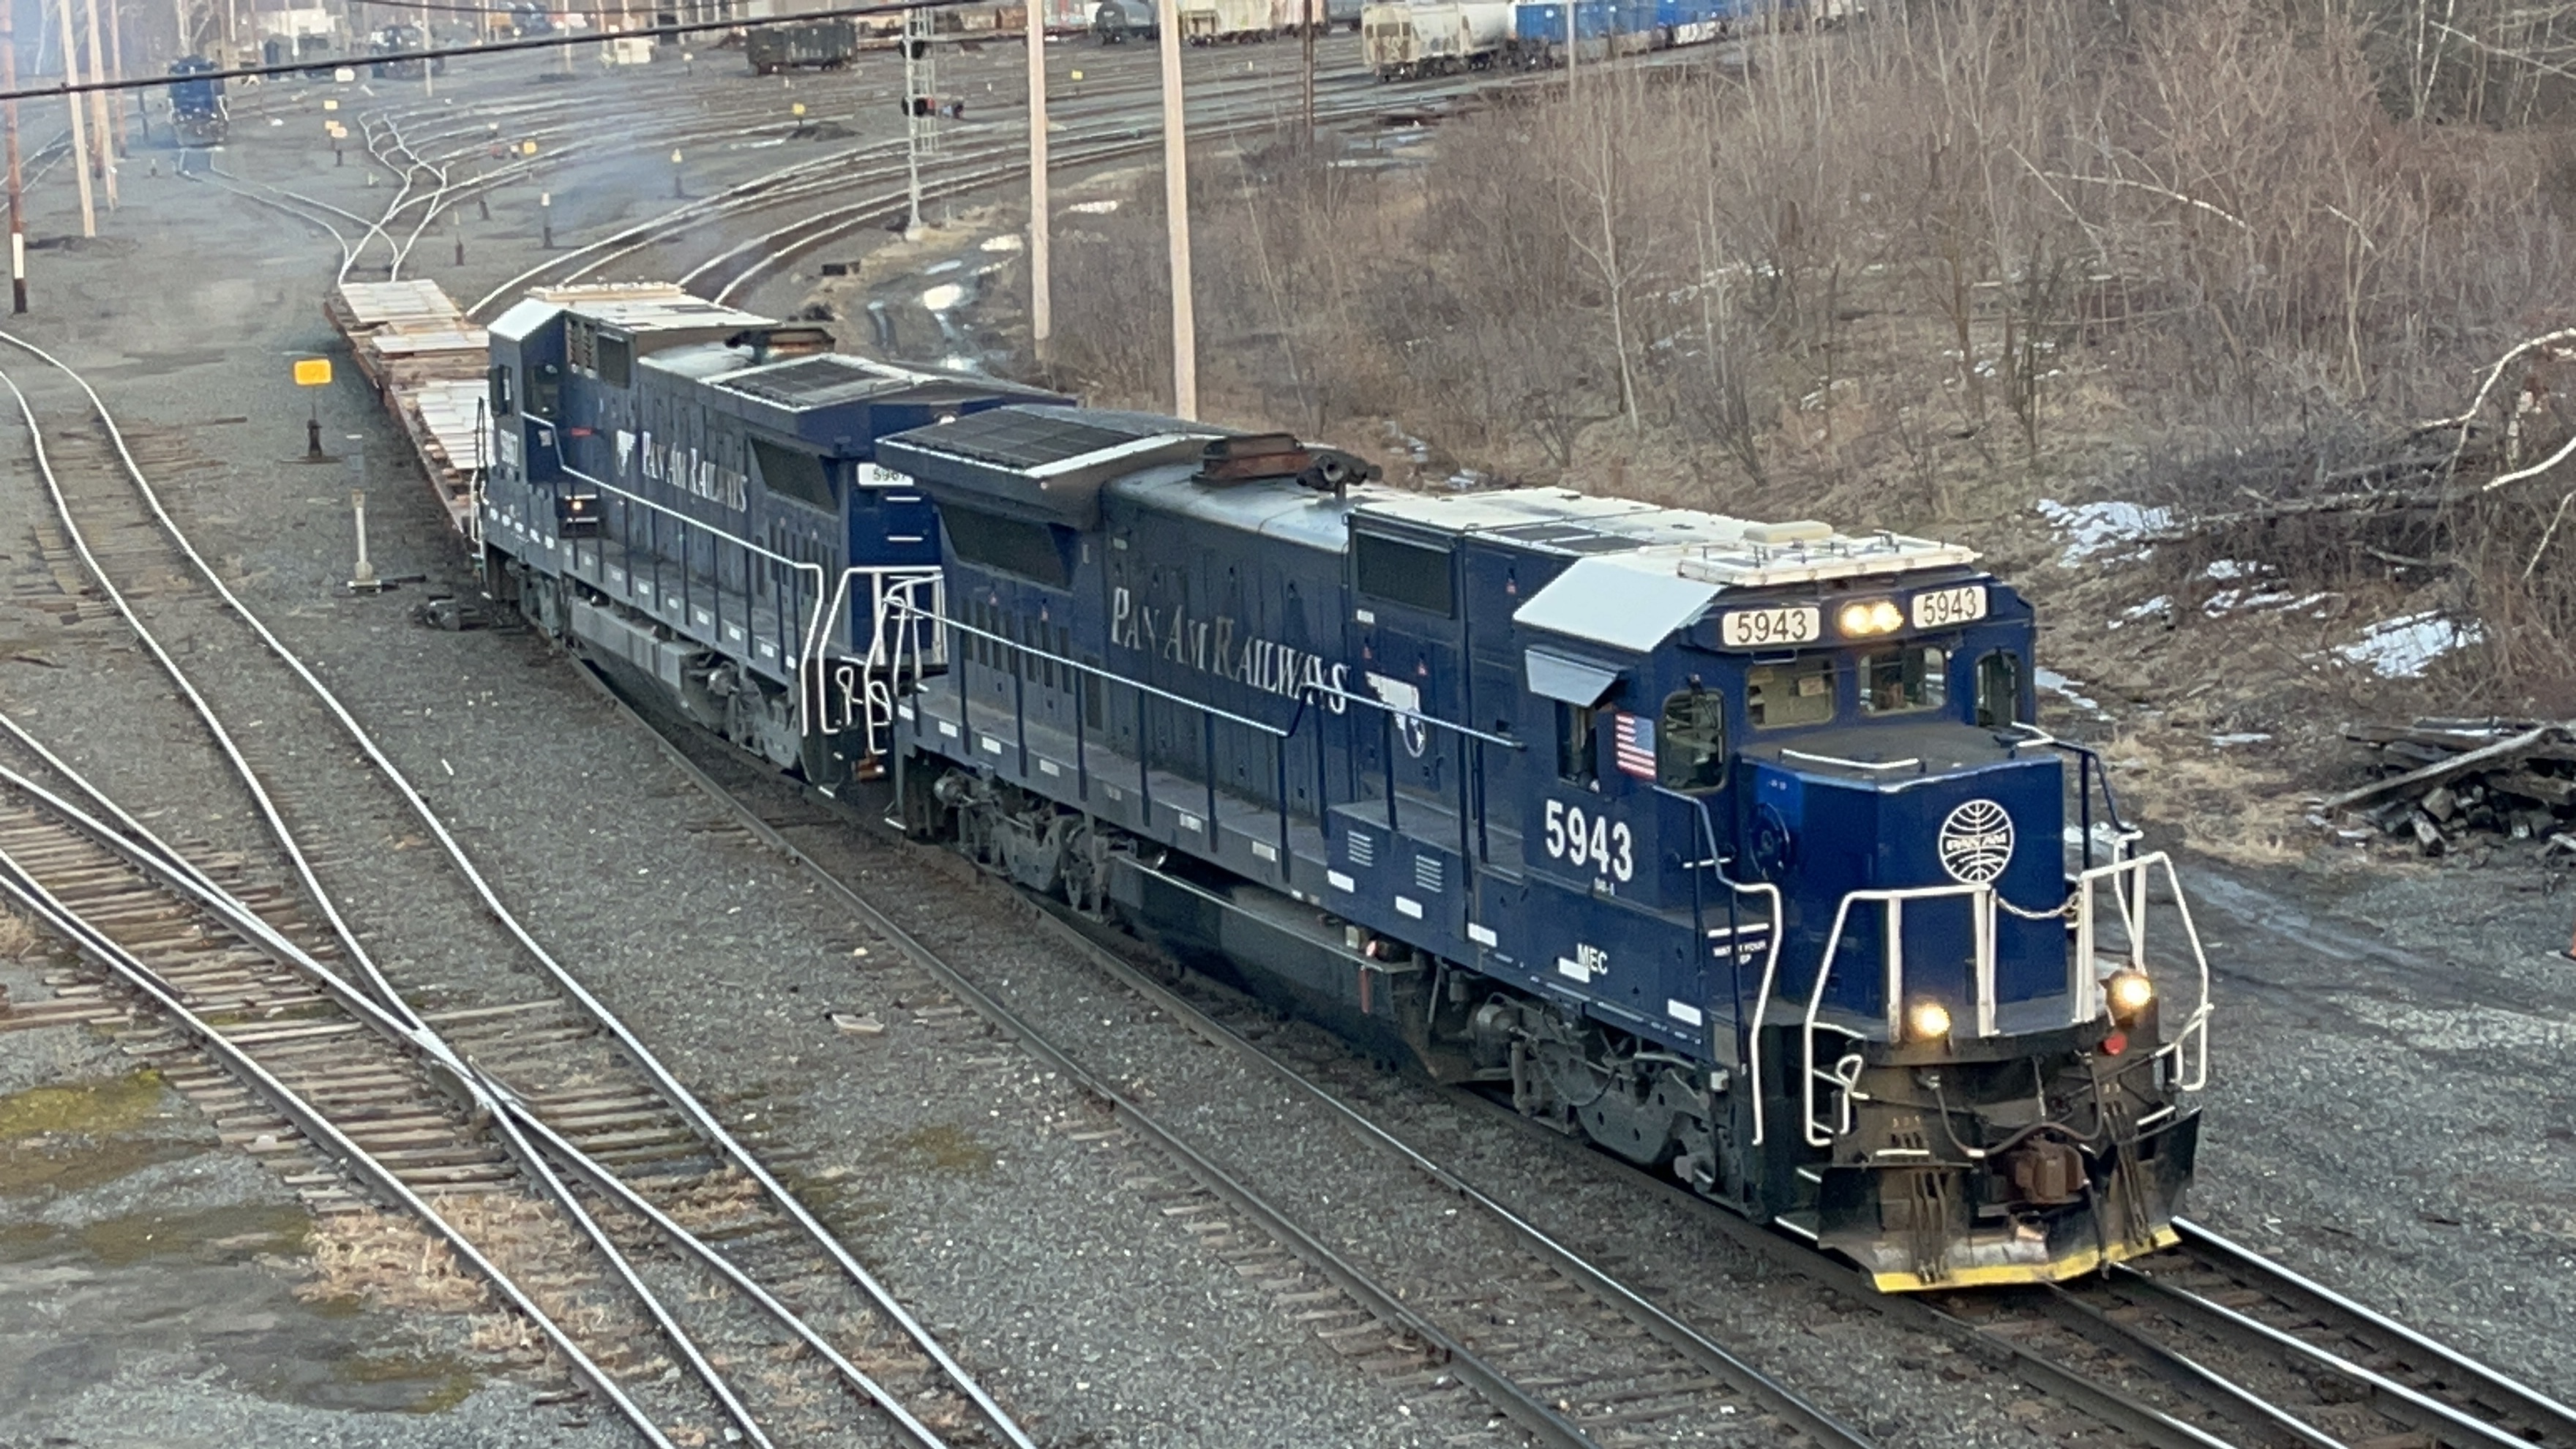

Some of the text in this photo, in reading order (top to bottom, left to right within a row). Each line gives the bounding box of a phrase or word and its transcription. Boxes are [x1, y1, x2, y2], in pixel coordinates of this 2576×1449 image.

[1922, 588, 1977, 624] 5943
[1737, 610, 1807, 643] 5943
[1111, 587, 1352, 715] PAN AM RAILWAYS
[1545, 797, 1633, 882] 5943
[1577, 941, 1608, 975] MEC
